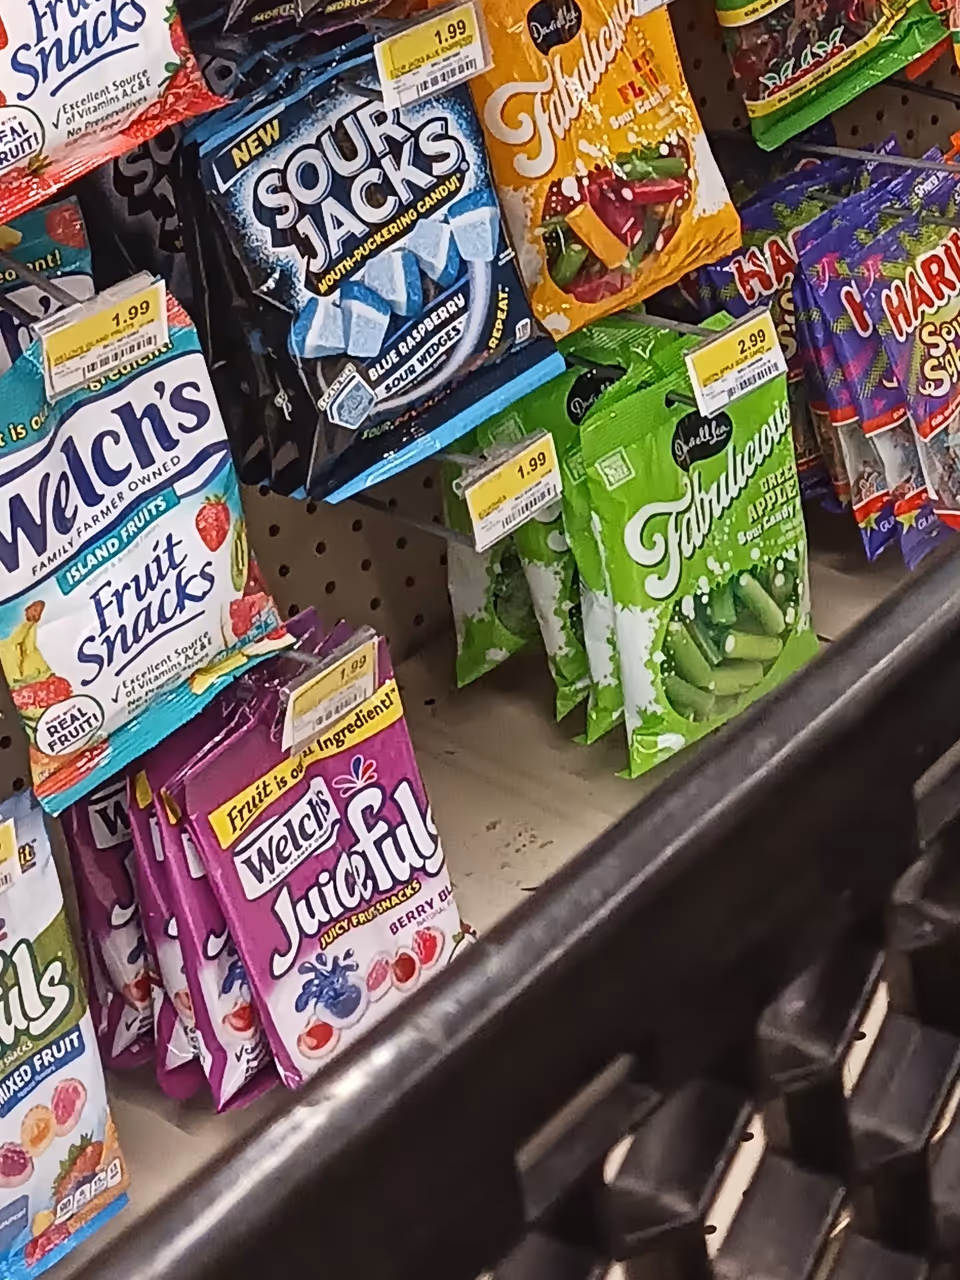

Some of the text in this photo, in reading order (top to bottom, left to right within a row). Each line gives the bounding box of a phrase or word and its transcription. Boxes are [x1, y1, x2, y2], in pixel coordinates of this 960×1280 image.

[434, 19, 468, 46] 1.99
[61, 69, 149, 114] Excellent Source
[65, 94, 120, 126] of Vitamins
[66, 126, 82, 139] No
[84, 95, 148, 132] Preservatives
[231, 118, 282, 169] NEW
[254, 97, 415, 231] SOUR
[294, 116, 463, 275] JACKS
[315, 171, 463, 294] MOUTH-PUCKERING CANDY!
[112, 299, 151, 328] 1.99
[367, 292, 467, 382] BLUE RASPBERRY
[384, 324, 462, 395] SOUR WEDGES
[737, 328, 767, 354] 2.99
[9, 422, 27, 442] is
[0, 379, 212, 576] Welch's
[517, 451, 547, 480] 1.99
[31, 454, 182, 576] FAMILY FARMER OWNED
[736, 503, 796, 545] Sour Candy
[747, 482, 797, 522] APPLE
[65, 494, 168, 584] ISLAND FRUITS
[91, 533, 188, 638] Fruit
[76, 561, 216, 686] Snacks
[121, 654, 172, 689] Excellent
[174, 630, 210, 659] Source
[124, 685, 136, 698] of
[136, 661, 183, 695] Vitamins
[339, 654, 367, 681] 1.99
[46, 706, 88, 739] REAL
[47, 712, 100, 753] FRUIT!
[315, 691, 395, 753] Ingredient!
[225, 773, 289, 835] Fruit is
[320, 922, 351, 950] JUICY
[374, 880, 422, 917] SNACKS
[388, 898, 436, 937] BERRY
[33, 1030, 81, 1071] FRUIT
